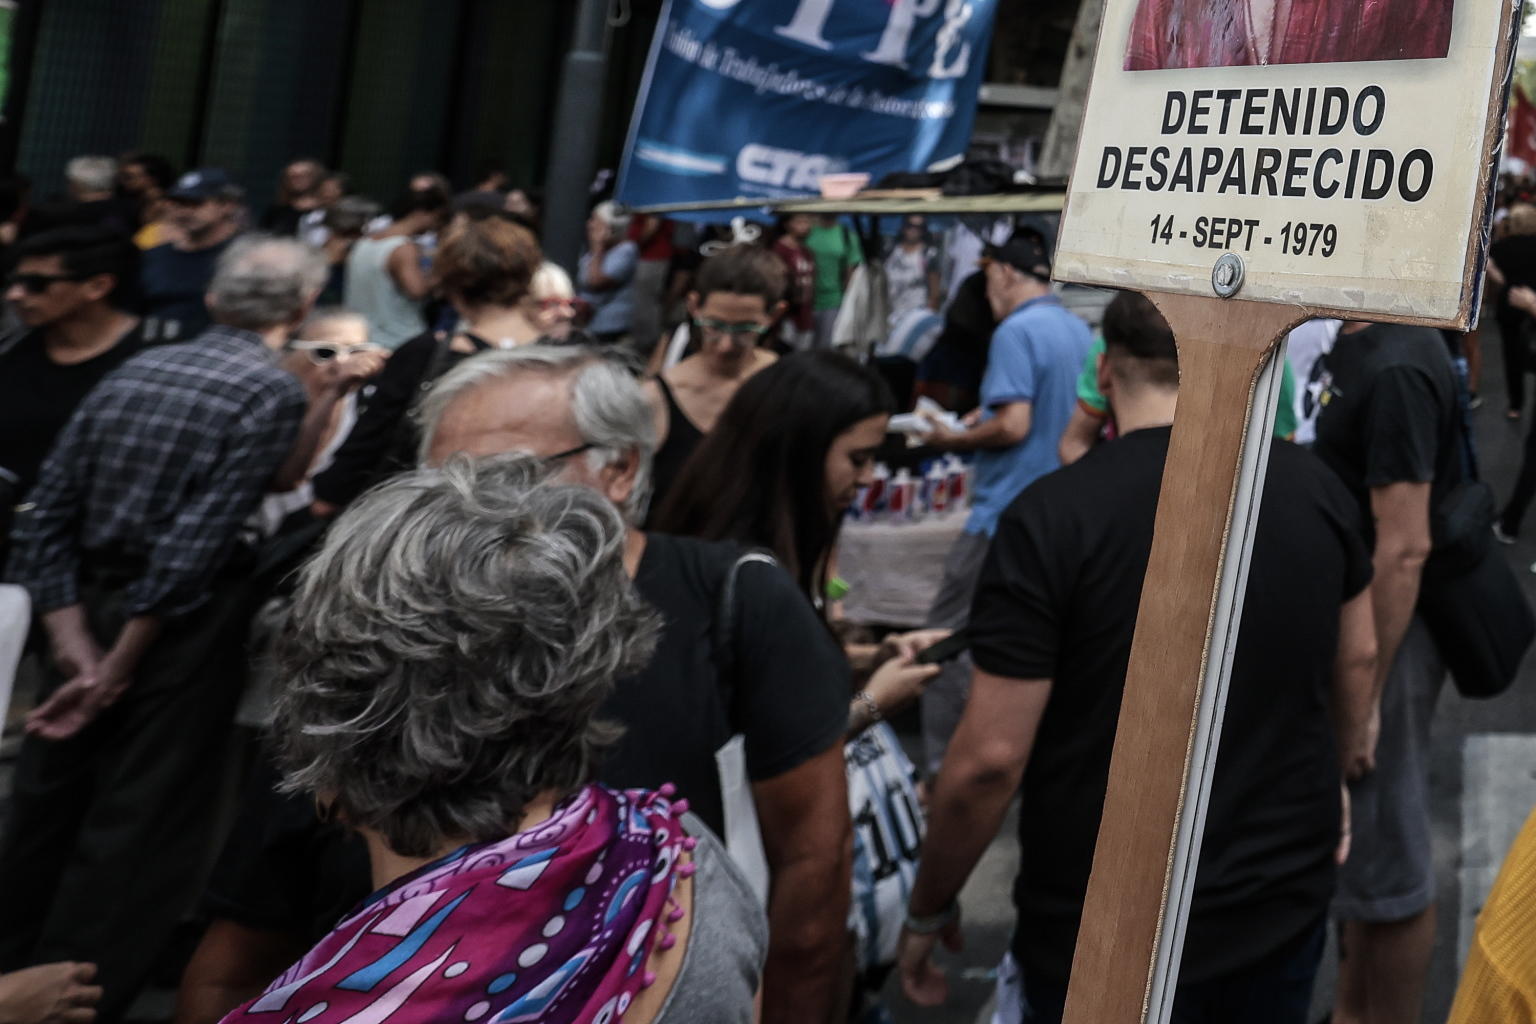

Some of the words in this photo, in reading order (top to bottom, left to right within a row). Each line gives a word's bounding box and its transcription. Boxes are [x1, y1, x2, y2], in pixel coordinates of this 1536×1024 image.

[1160, 85, 1386, 136] DETENIDO
[1096, 145, 1434, 203] DESAPARECIDO
[1150, 214, 1175, 245] 14
[1193, 216, 1260, 251] SEPT
[1280, 221, 1338, 258] 1979
